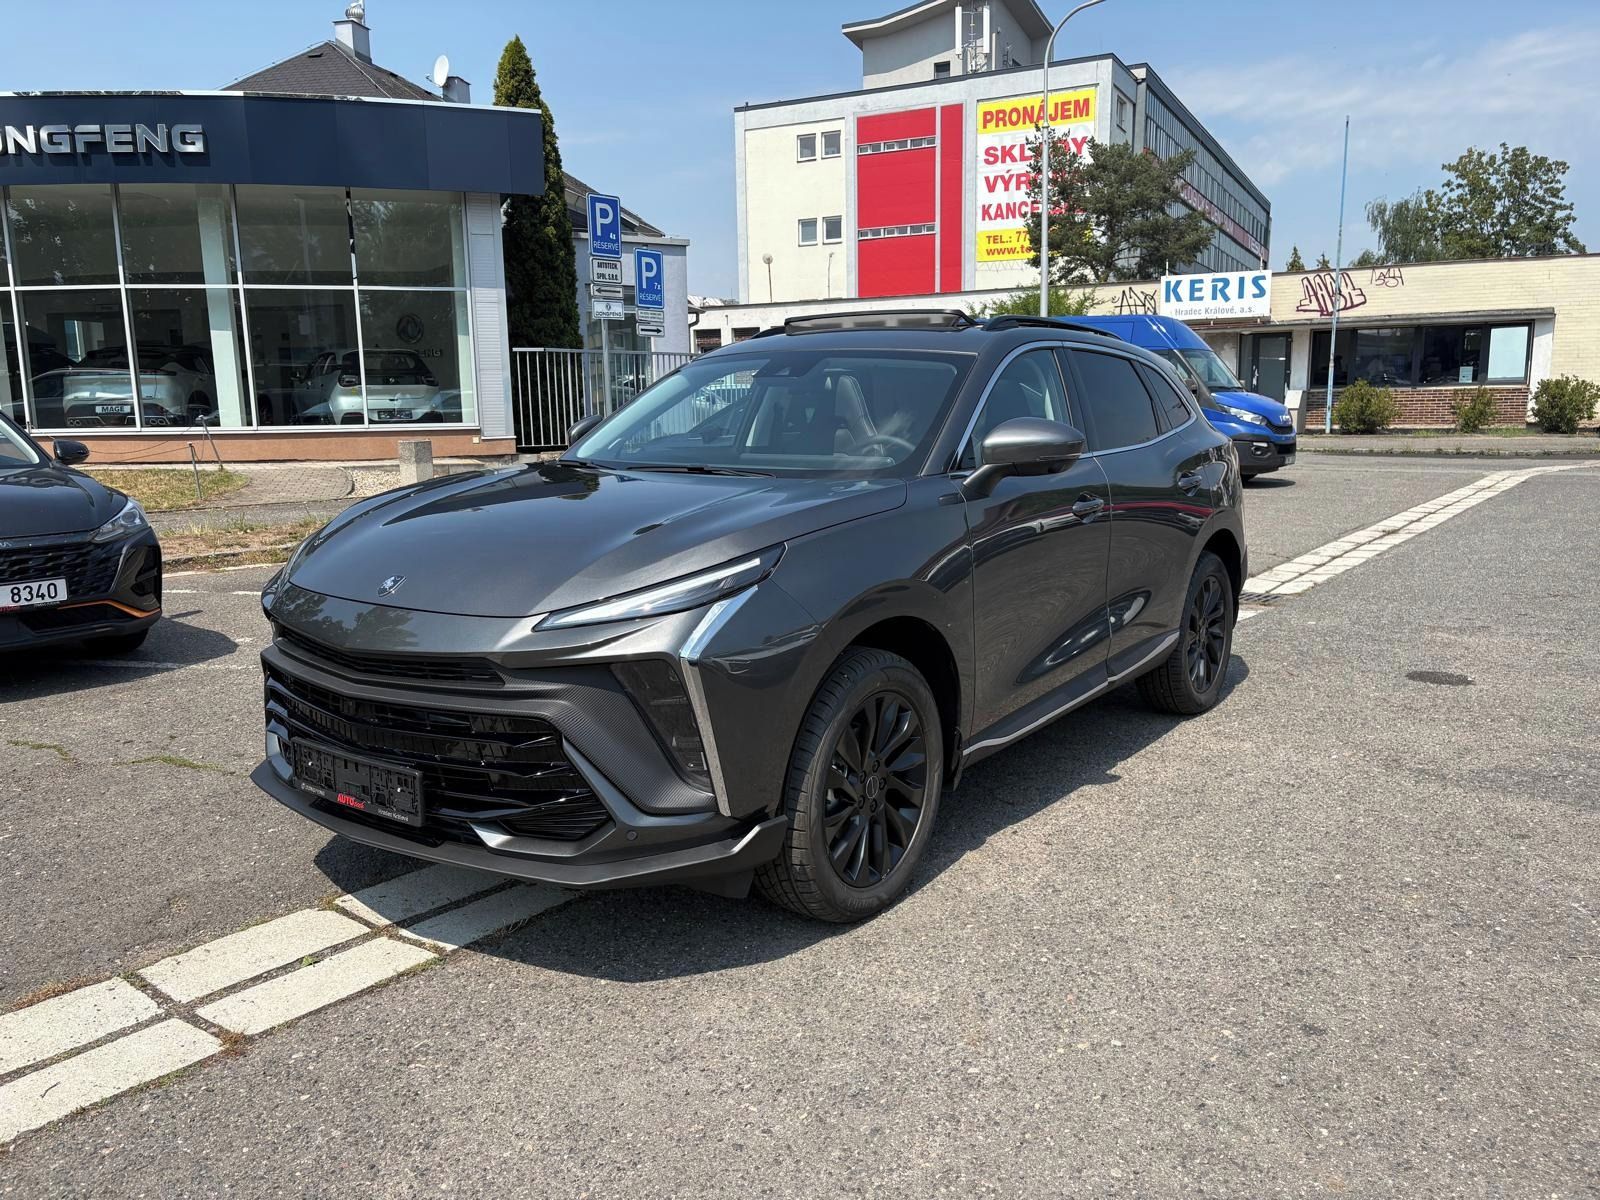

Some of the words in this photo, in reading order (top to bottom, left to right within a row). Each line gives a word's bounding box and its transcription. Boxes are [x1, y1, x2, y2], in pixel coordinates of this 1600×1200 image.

[983, 97, 1090, 129] PRONÁJEM
[0, 123, 204, 154] NGFENG
[983, 136, 1088, 165] SKLY
[595, 202, 614, 236] P
[986, 234, 1012, 244] TEL.:
[641, 256, 657, 289] P
[1165, 275, 1266, 302] KERIS
[1175, 308, 1202, 316] Hradec
[1204, 306, 1237, 315] Králové,
[10, 582, 58, 603] 8340
